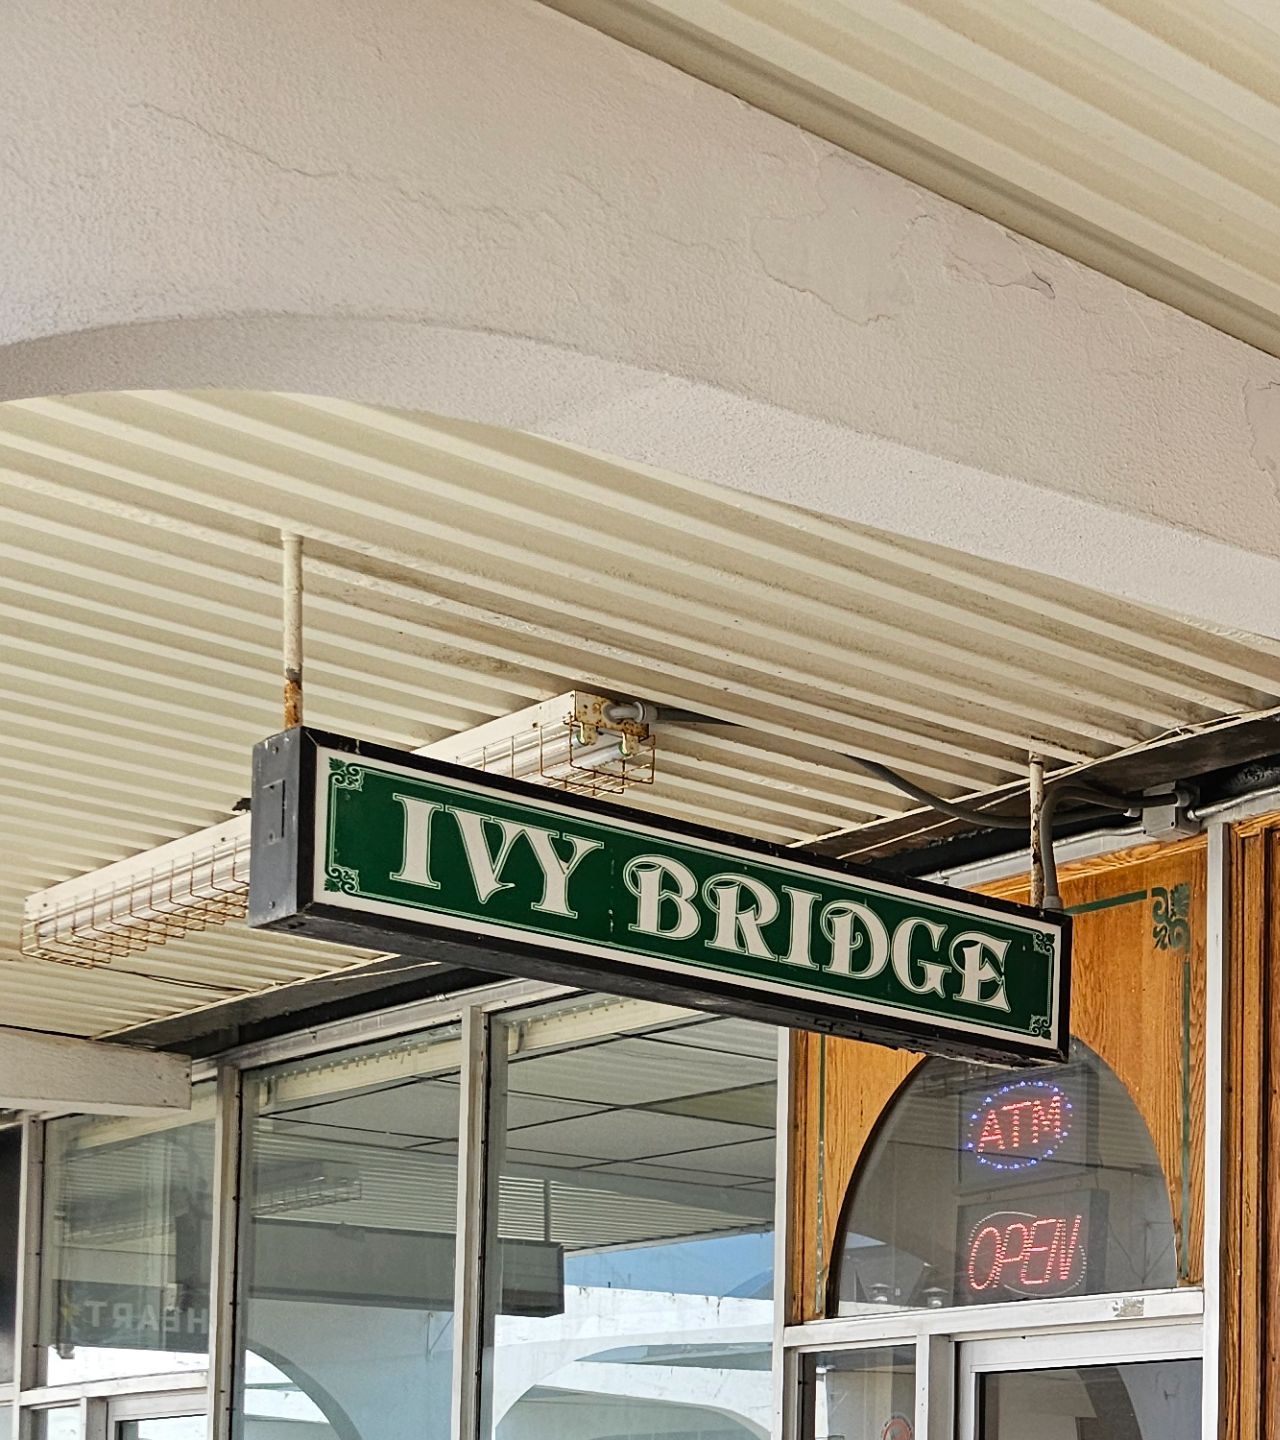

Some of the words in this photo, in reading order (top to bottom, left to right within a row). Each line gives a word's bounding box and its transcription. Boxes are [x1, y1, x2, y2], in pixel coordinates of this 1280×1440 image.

[389, 793, 604, 921] IVY
[622, 854, 1012, 1013] BRIDGE
[977, 1094, 1062, 1153] ATM
[967, 1214, 1083, 1291] OPEN
